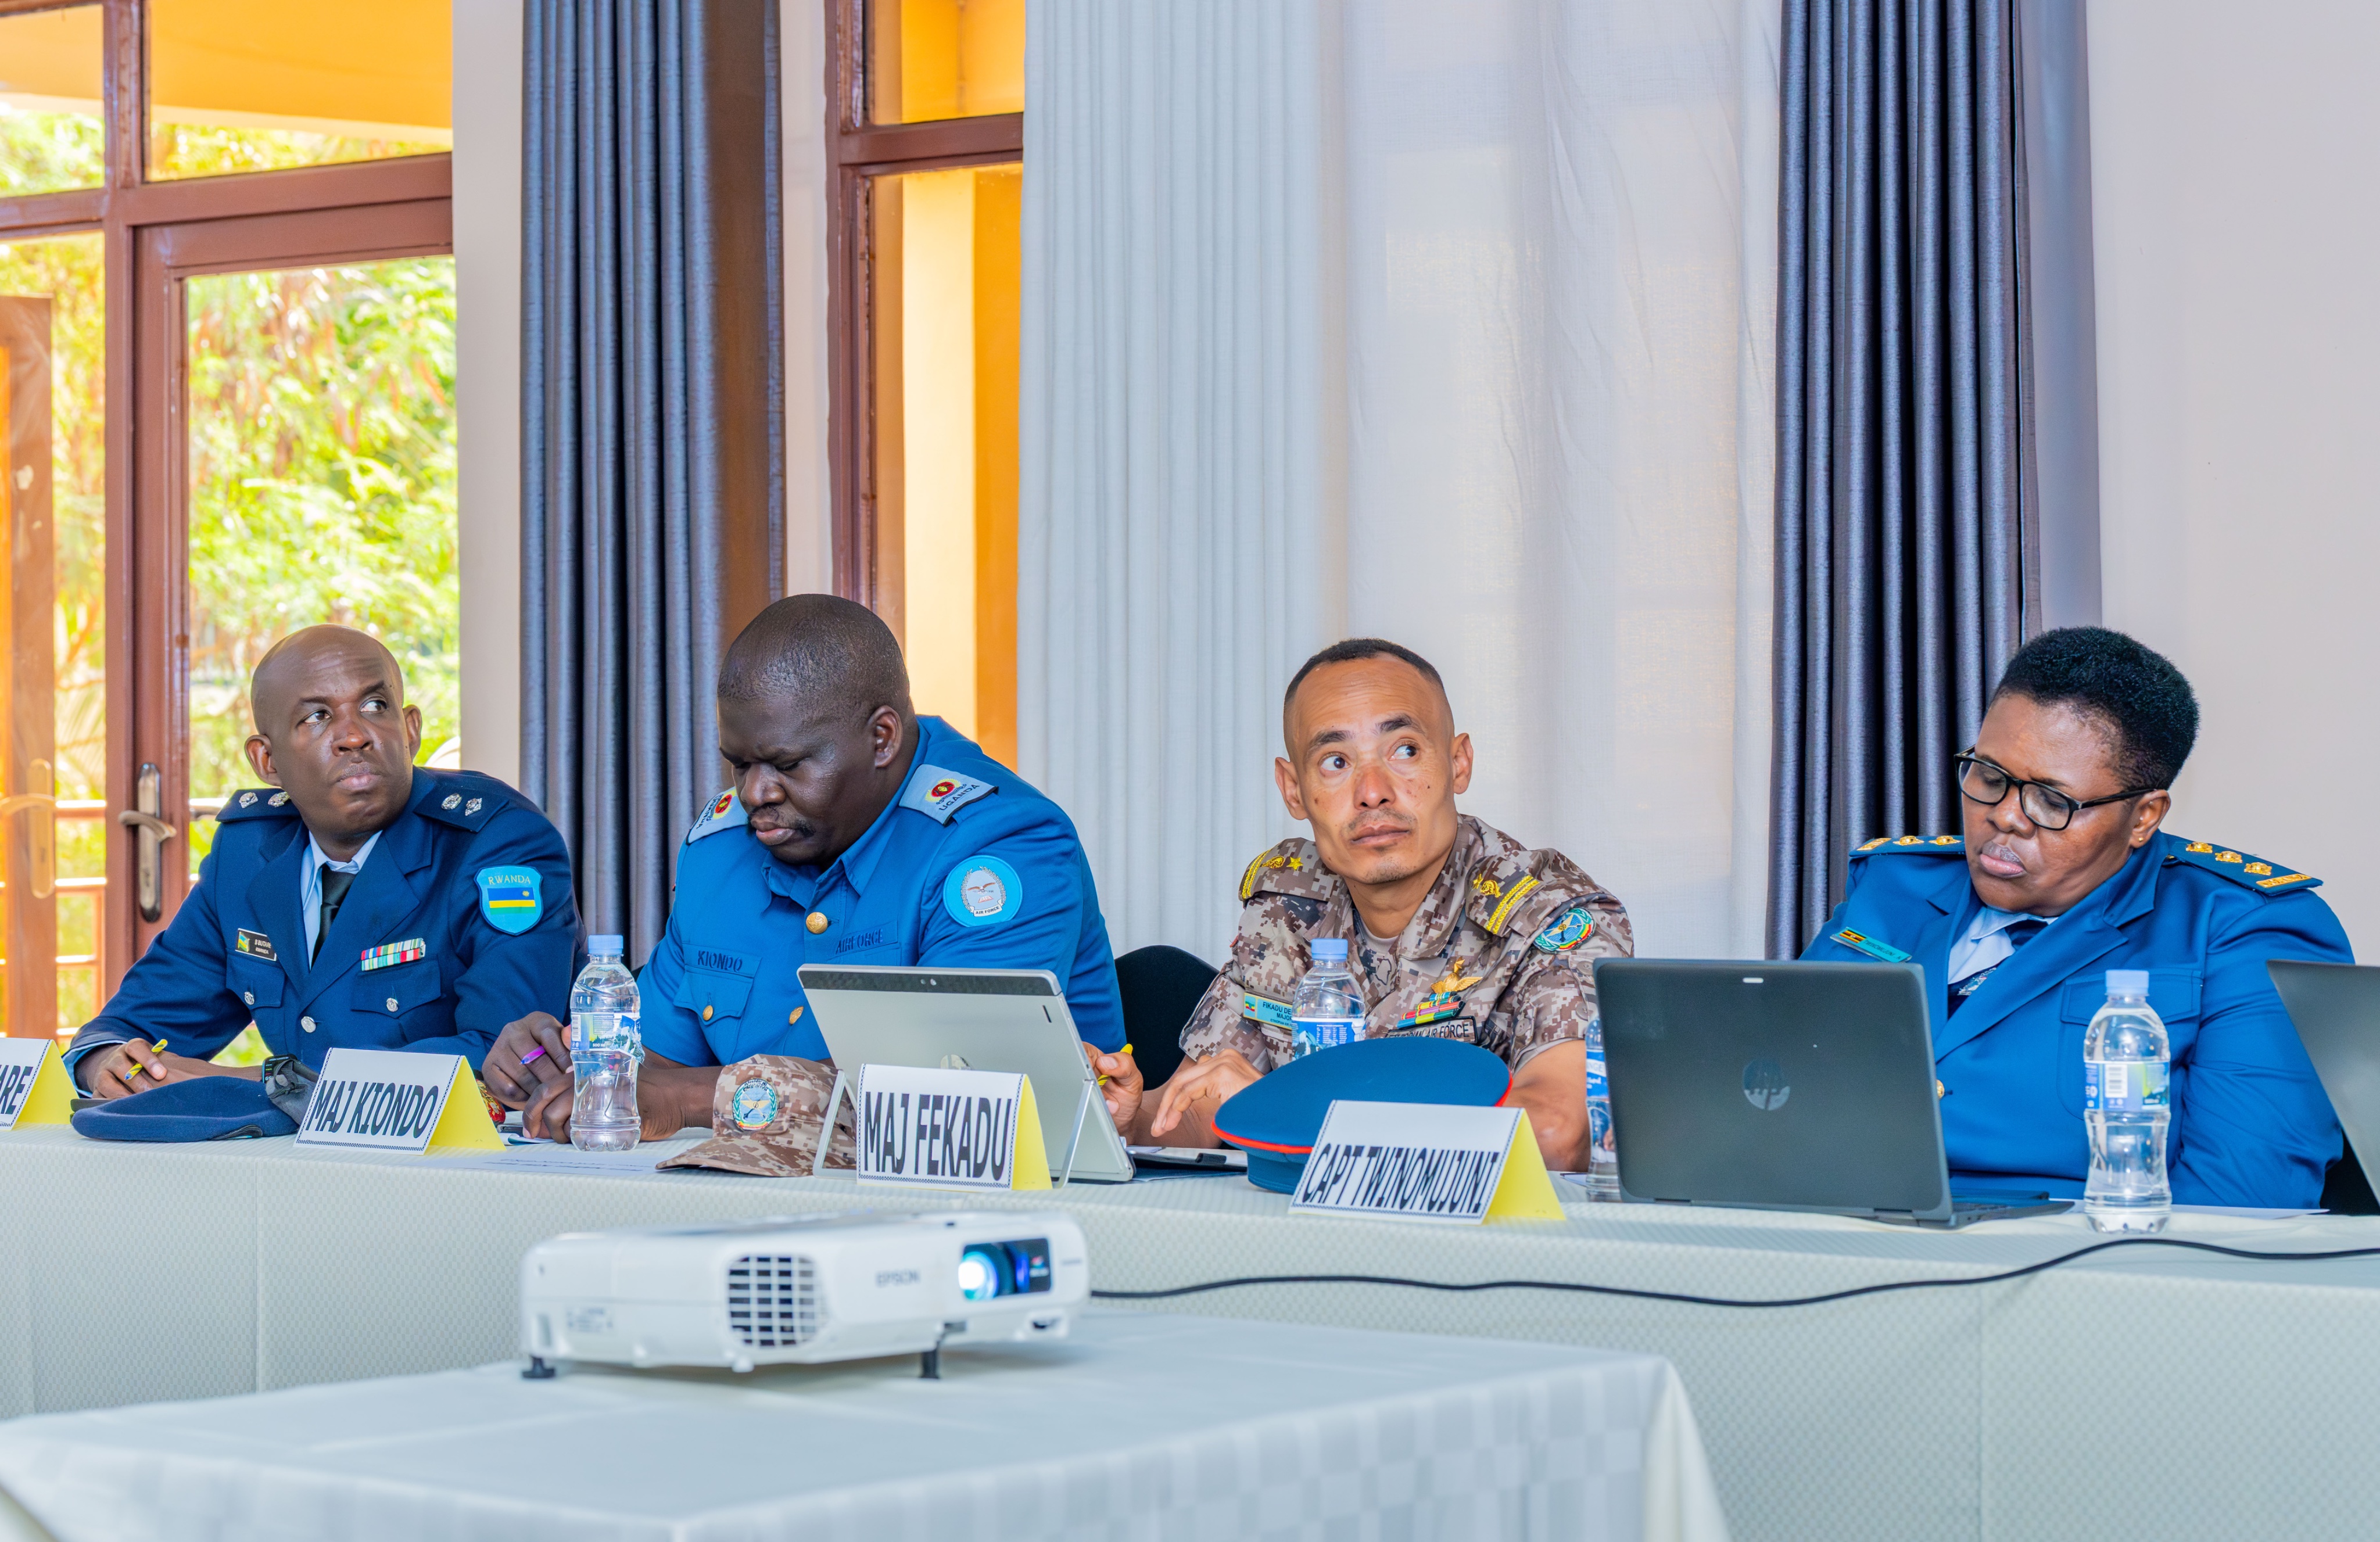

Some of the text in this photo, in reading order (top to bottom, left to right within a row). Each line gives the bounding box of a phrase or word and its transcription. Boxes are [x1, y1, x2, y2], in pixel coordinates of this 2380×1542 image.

[939, 784, 980, 811] UGANDA
[488, 874, 531, 885] RWANDA
[697, 950, 743, 973] KIONDO
[1263, 1002, 1283, 1012] FIKADU
[1439, 1023, 1469, 1038] FORCE
[305, 1080, 439, 1138] MAJ KIONDO
[864, 1091, 1012, 1181] MAJ FEKADU
[1302, 1143, 1500, 1213] CAPT TWINOMUJUNI
[876, 1270, 920, 1287] EPSON
